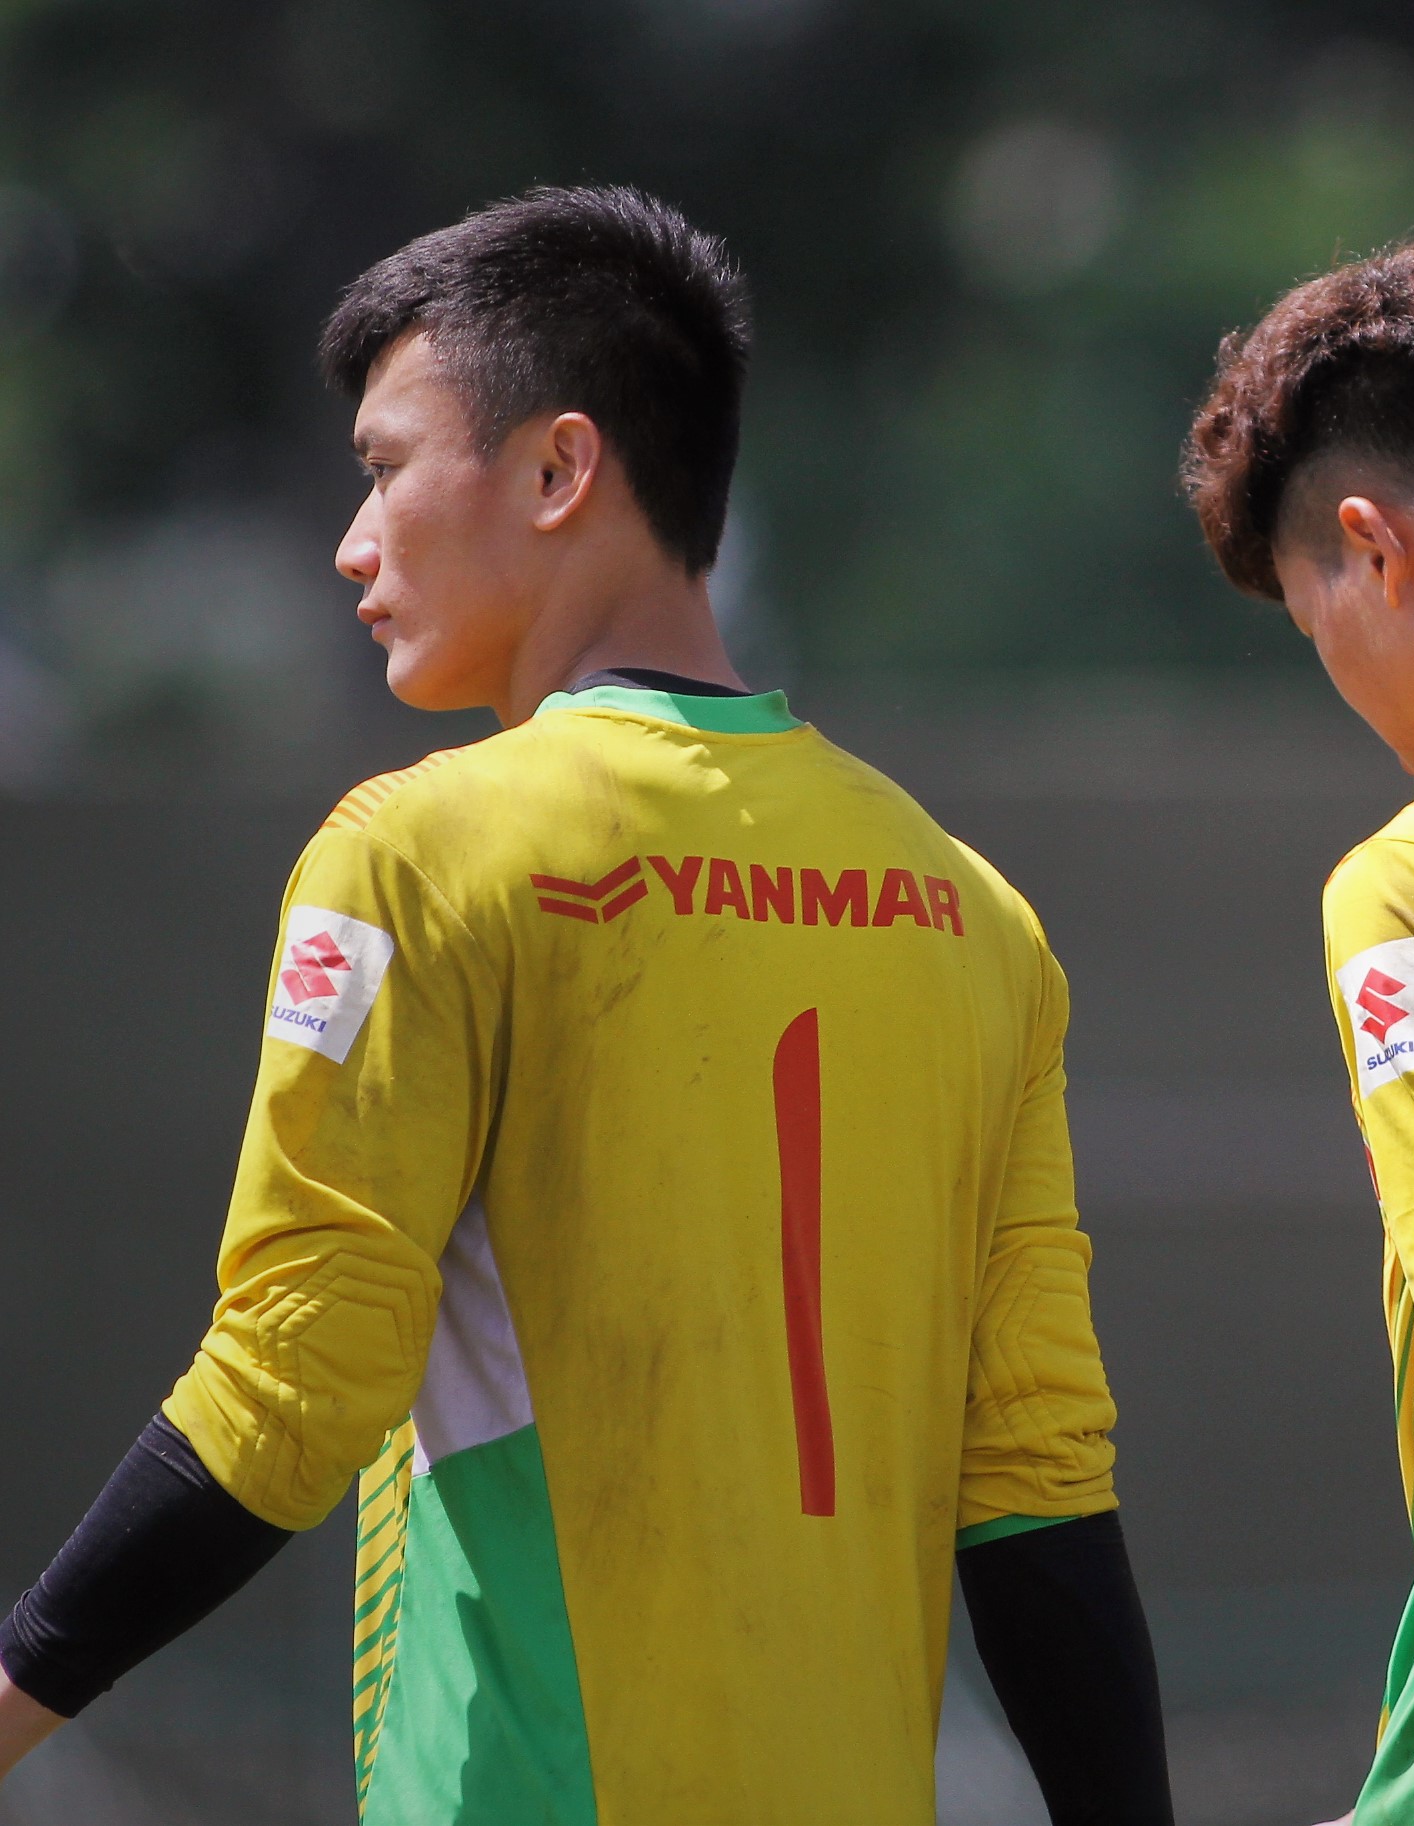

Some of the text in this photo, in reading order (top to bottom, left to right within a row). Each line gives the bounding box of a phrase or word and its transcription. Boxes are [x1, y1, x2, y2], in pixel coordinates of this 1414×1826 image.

[645, 855, 966, 937] YANMAR
[270, 1004, 327, 1033] UZUKI
[772, 1007, 835, 1517] 1
